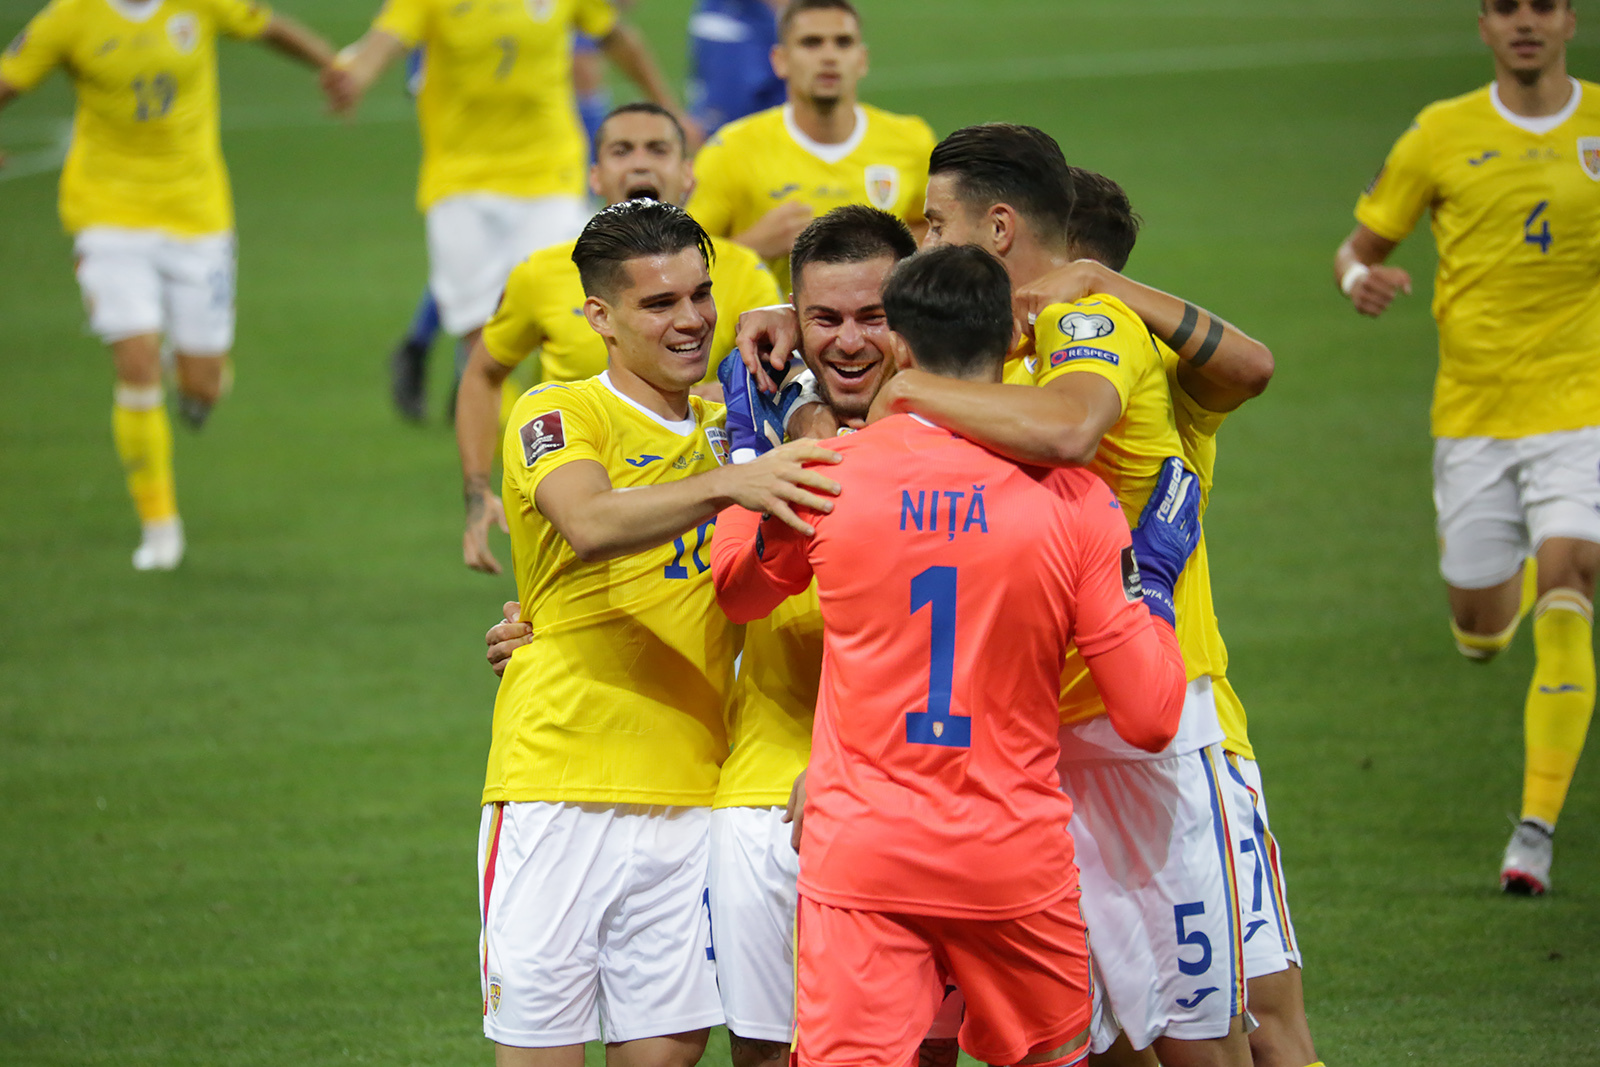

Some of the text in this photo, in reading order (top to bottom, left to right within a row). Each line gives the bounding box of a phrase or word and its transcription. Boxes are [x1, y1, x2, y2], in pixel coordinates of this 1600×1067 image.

[1524, 200, 1552, 254] 4
[1068, 347, 1119, 363] RESPECT
[900, 484, 989, 542] NIȚĂ
[1156, 457, 1184, 522] reusch
[906, 565, 971, 748] 1
[1173, 901, 1212, 976] 5
